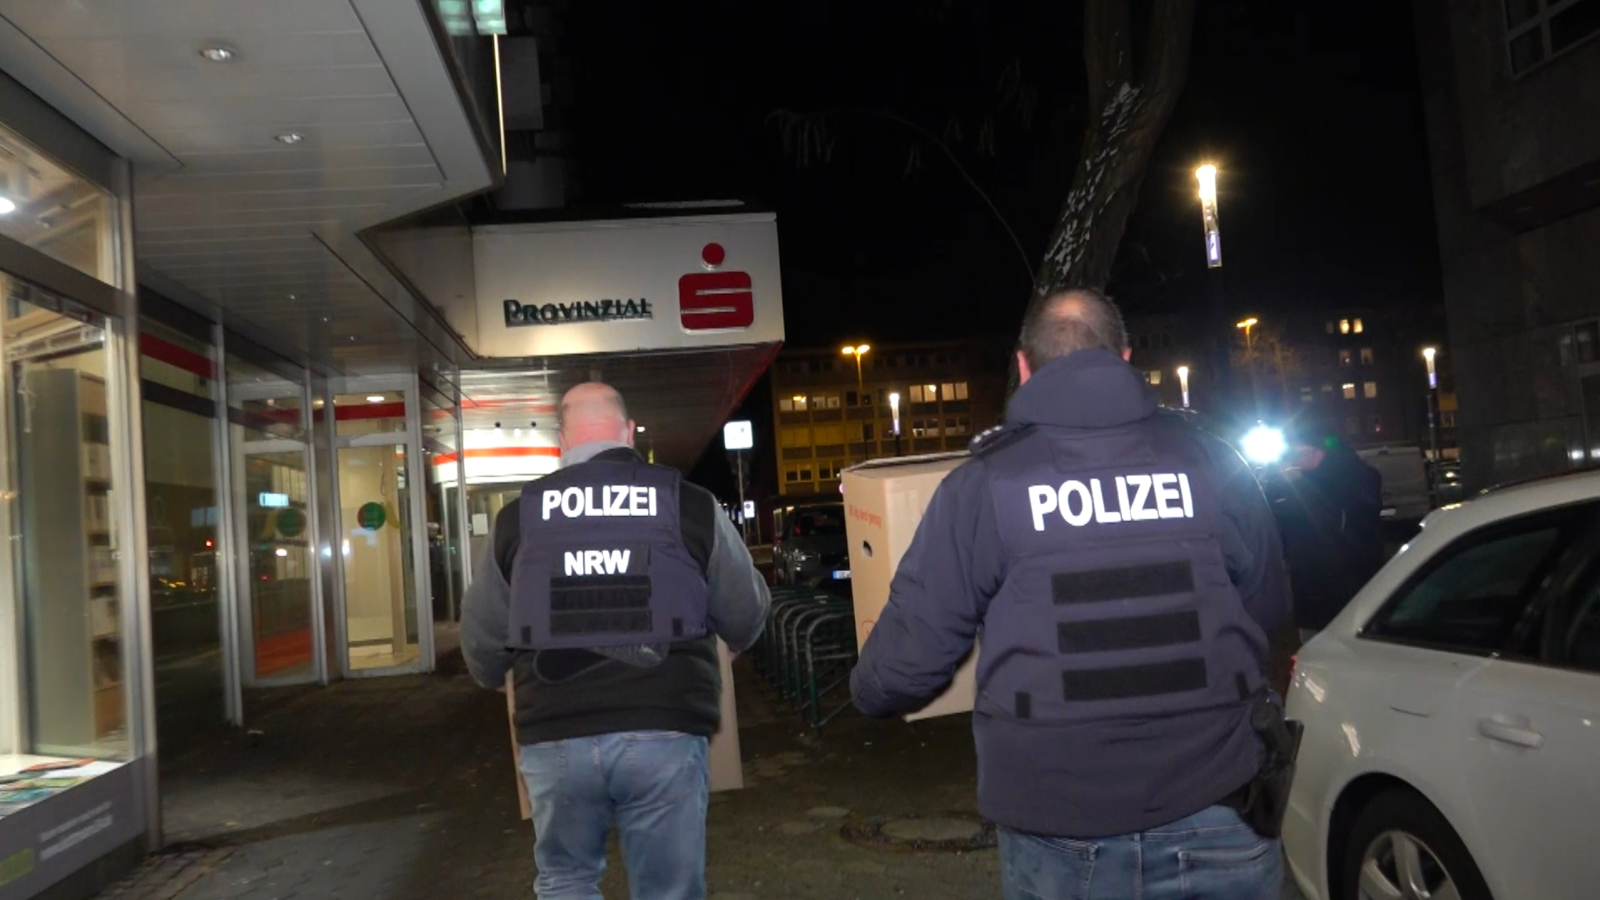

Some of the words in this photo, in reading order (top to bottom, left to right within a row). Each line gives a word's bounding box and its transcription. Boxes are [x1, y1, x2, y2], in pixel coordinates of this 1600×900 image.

[503, 298, 653, 327] PROVINZIAL
[542, 485, 657, 520] POLIZEI
[1028, 473, 1194, 531] POLIZEI
[564, 549, 631, 576] NRW
